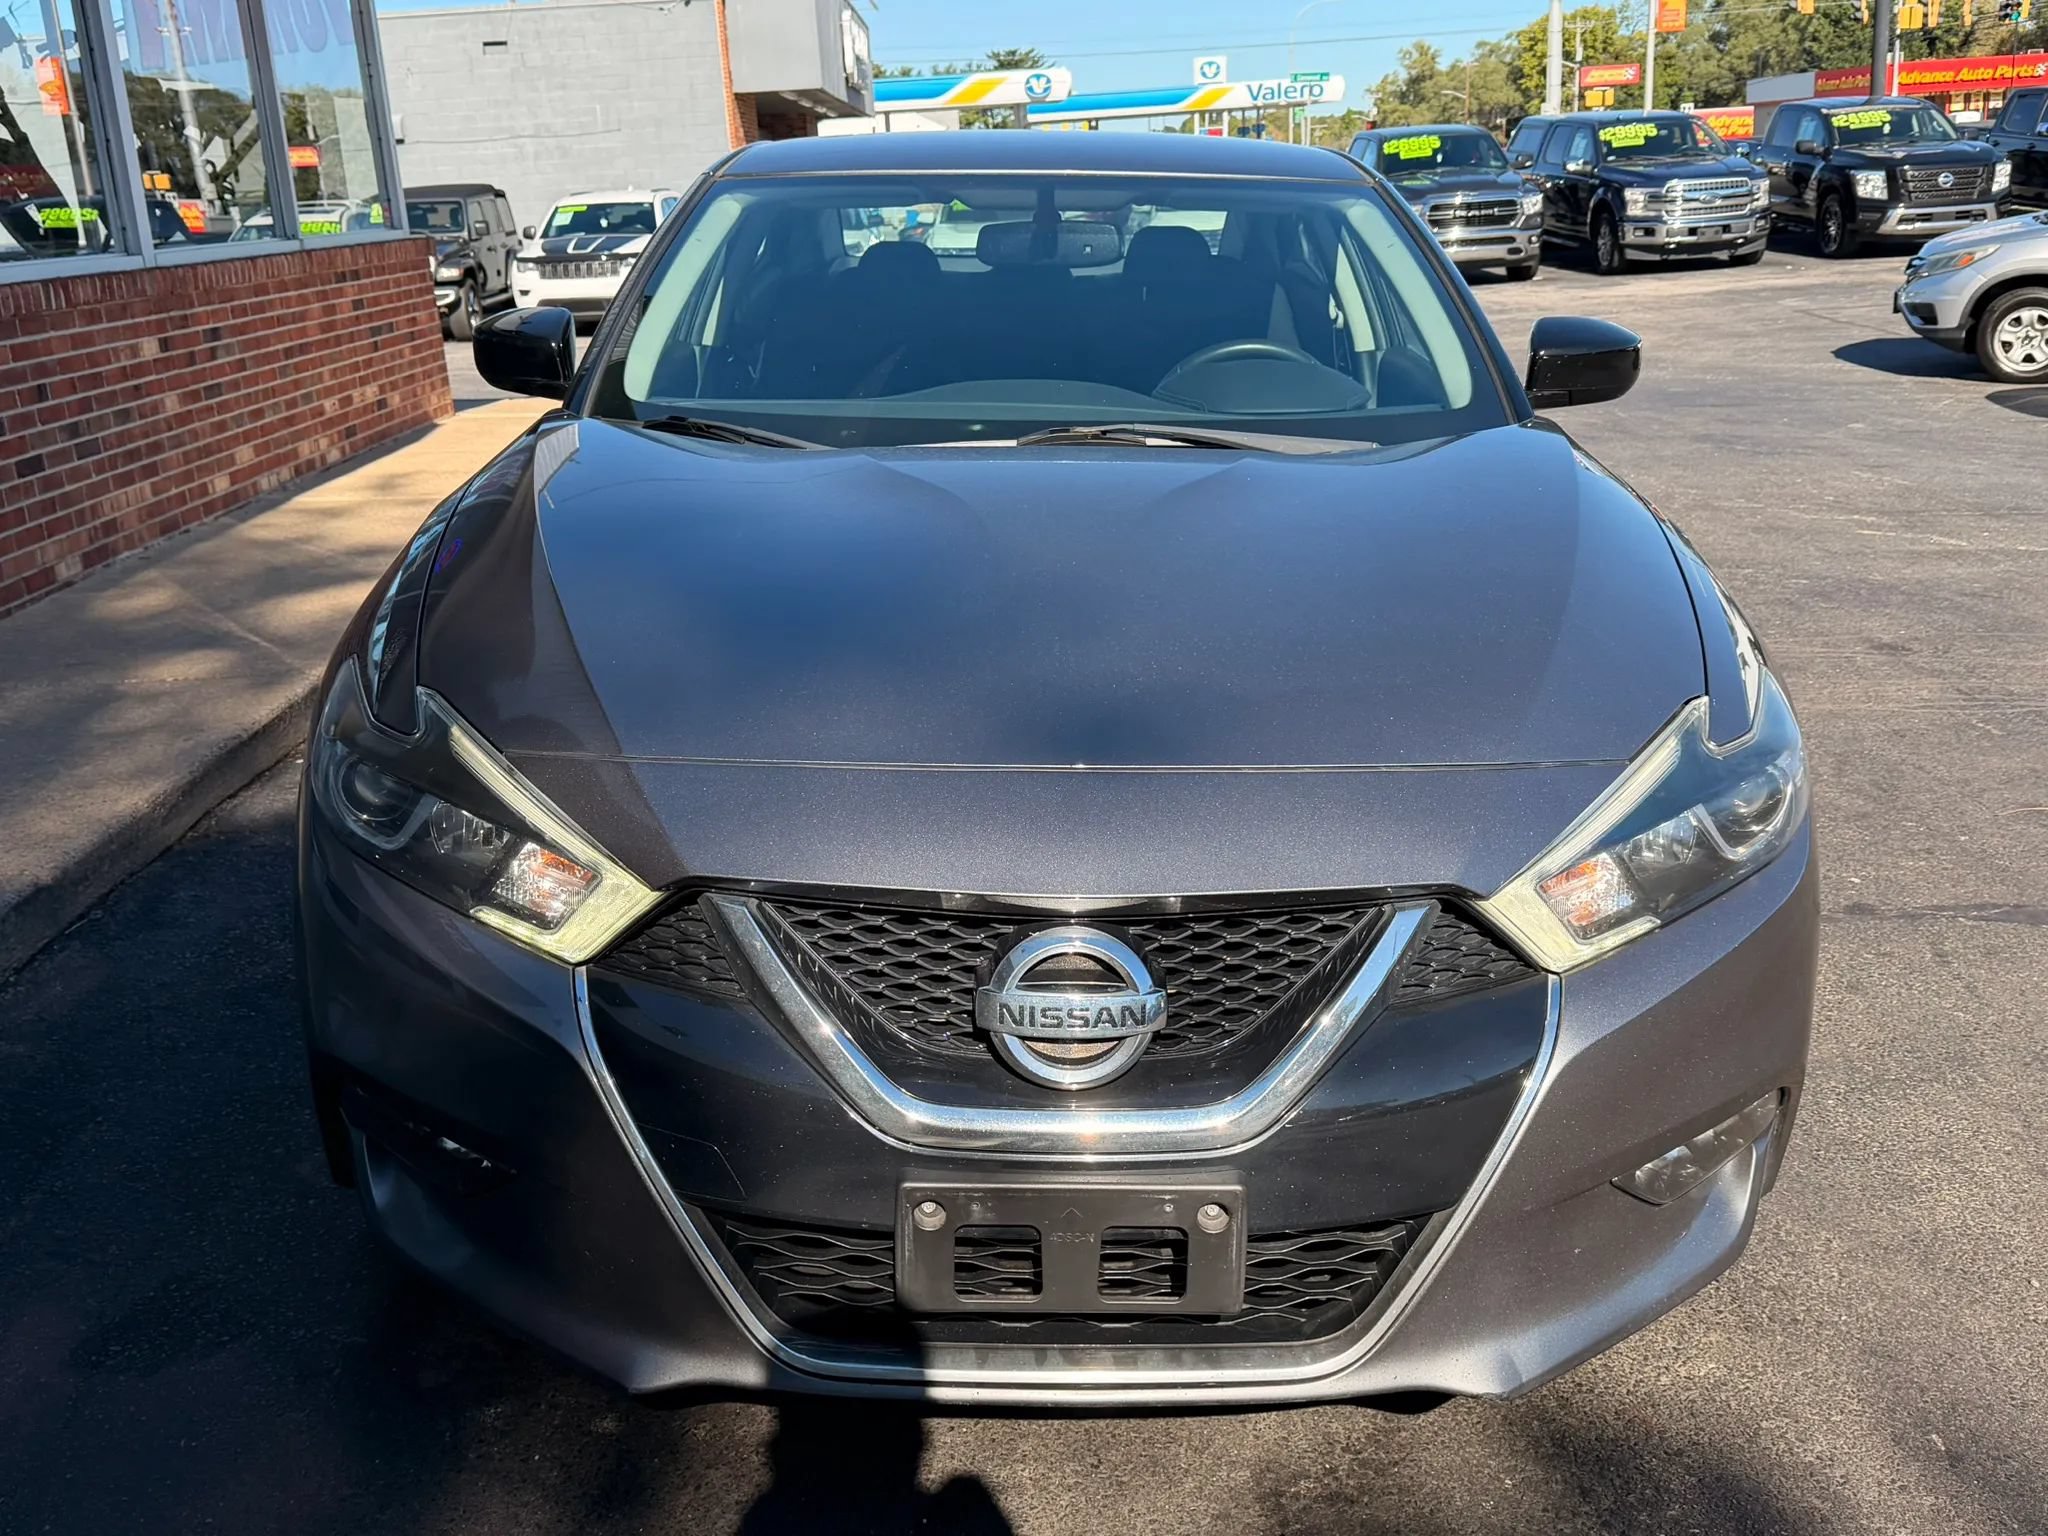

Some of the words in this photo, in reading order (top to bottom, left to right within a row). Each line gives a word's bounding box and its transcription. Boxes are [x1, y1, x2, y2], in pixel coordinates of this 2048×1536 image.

[1898, 70, 1955, 85] Advance
[1956, 67, 1994, 82] Auto
[1995, 64, 2034, 80] Parts
[1246, 82, 1324, 101] Valero
[1598, 123, 1658, 142] $29995
[997, 1001, 1148, 1029] NISSAN
